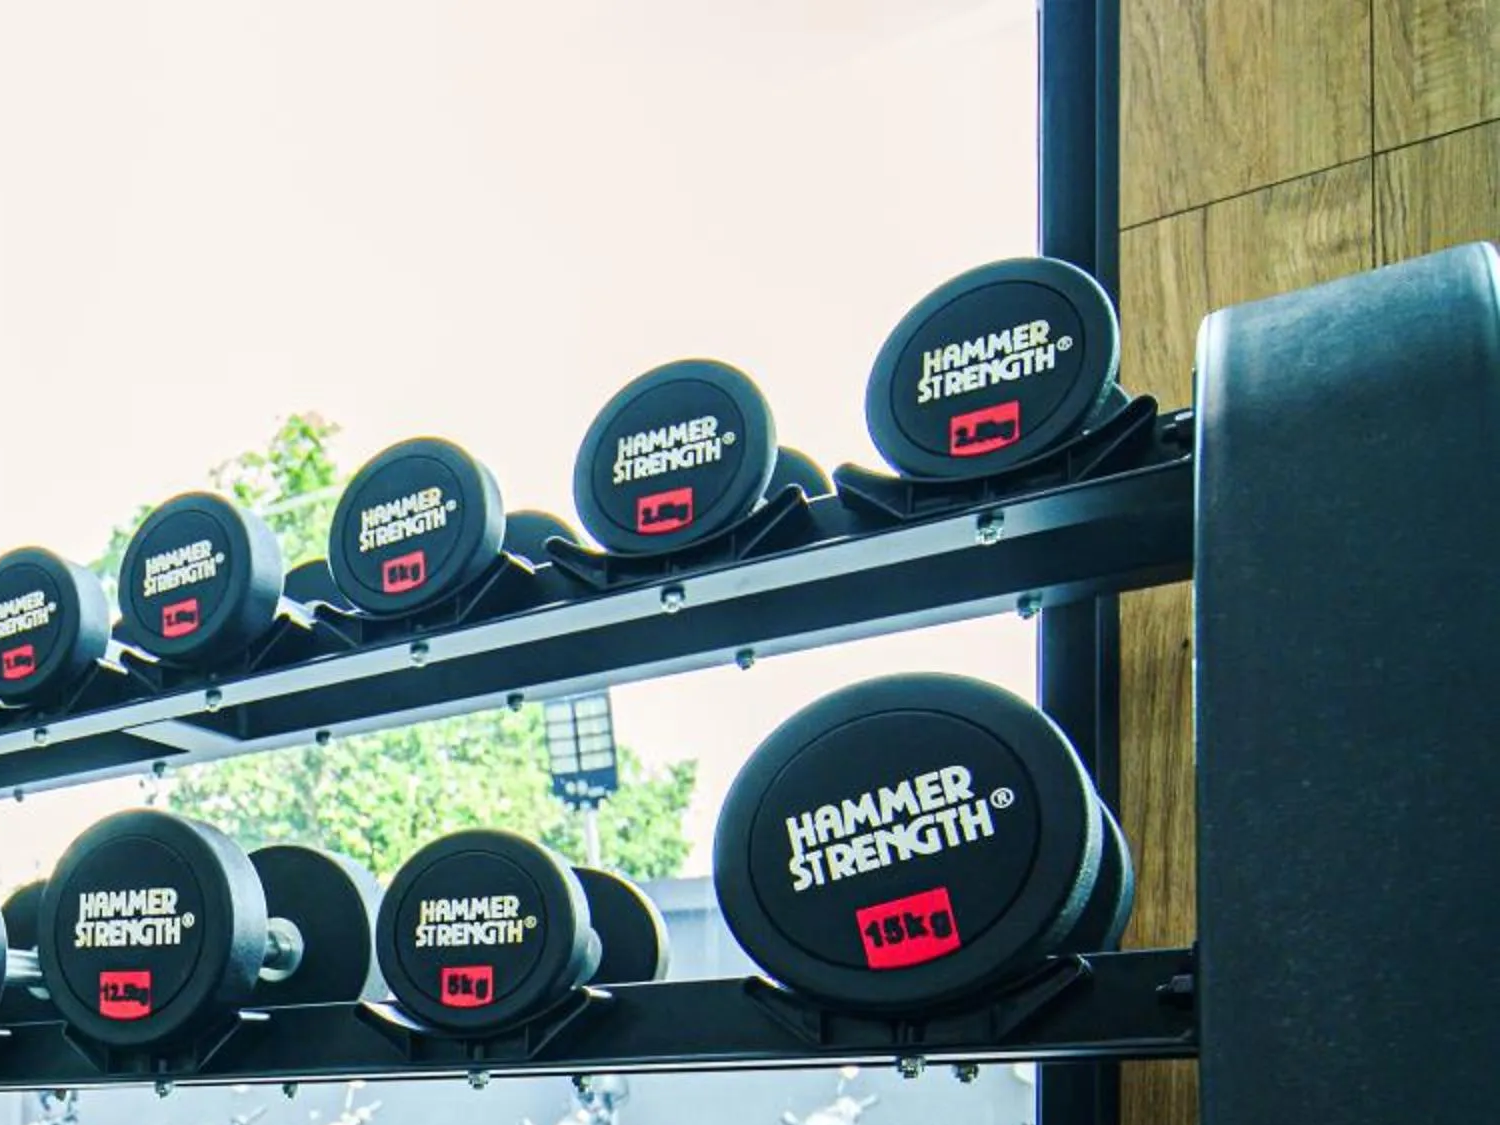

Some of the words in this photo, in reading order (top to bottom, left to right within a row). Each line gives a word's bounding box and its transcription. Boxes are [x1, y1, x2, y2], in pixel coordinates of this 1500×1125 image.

[923, 320, 1051, 377] HAMMER
[618, 415, 719, 460] HAMMER
[361, 487, 443, 530] HAMMER
[145, 539, 212, 576] HAMMER
[785, 765, 975, 855] HAMMER
[789, 787, 1015, 892] STRENGTH®
[79, 888, 178, 920] HAMMER
[420, 895, 520, 923] HAMMER
[864, 910, 954, 948] 15kg
